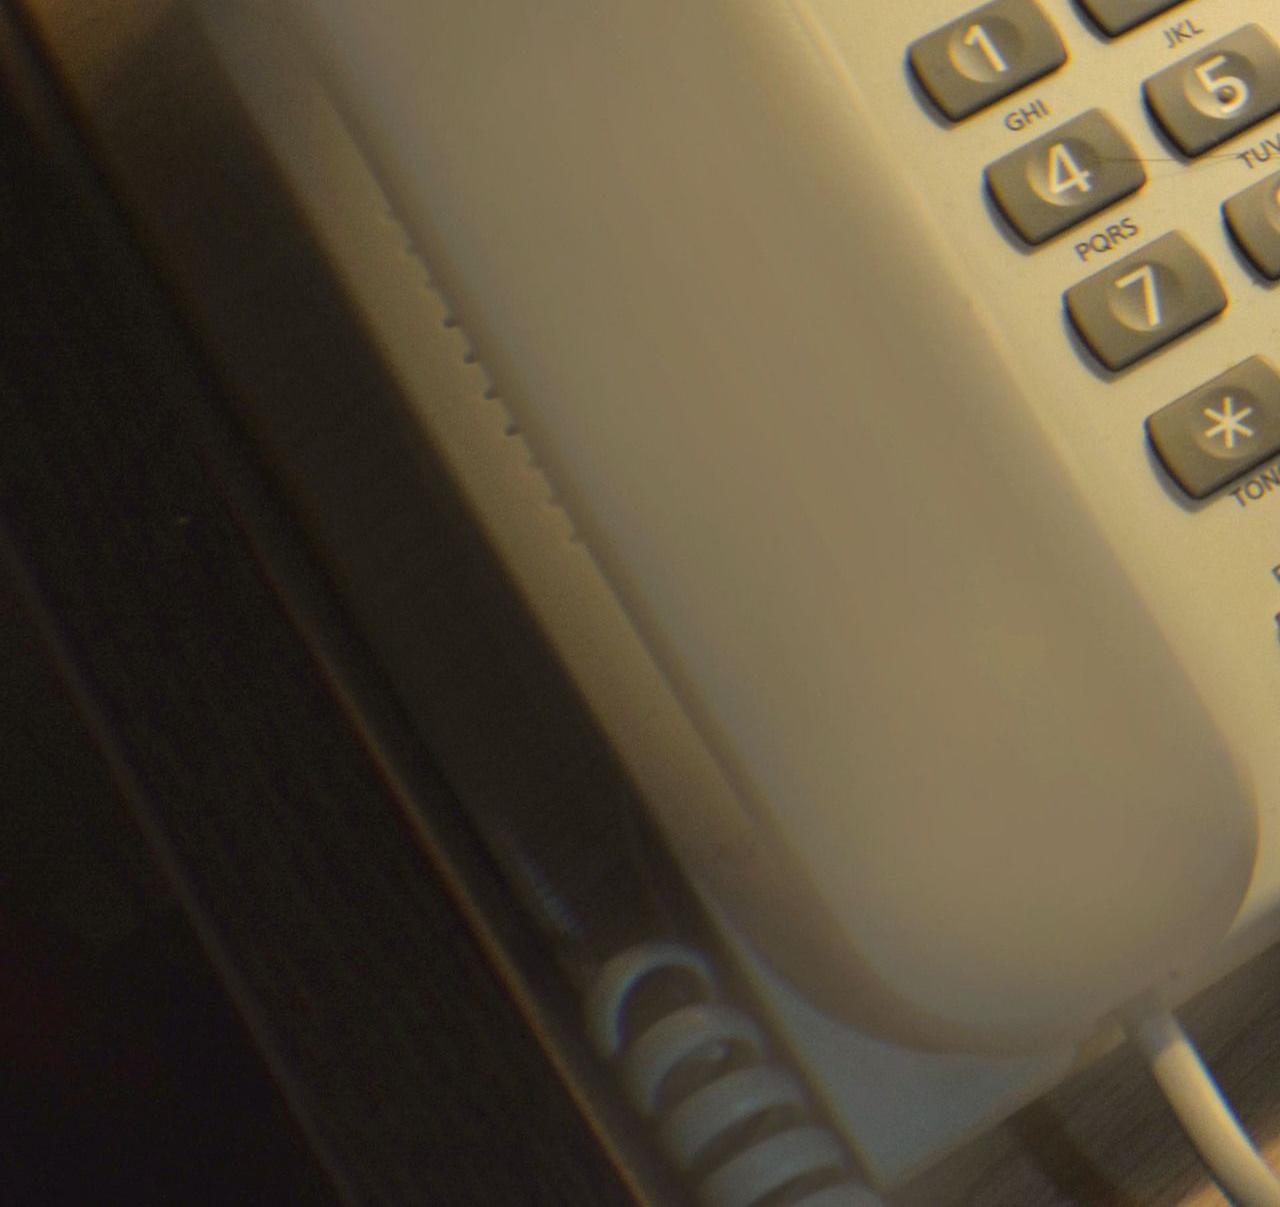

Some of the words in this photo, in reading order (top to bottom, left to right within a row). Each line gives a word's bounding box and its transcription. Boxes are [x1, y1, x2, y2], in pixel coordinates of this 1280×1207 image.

[964, 24, 1008, 73] 1
[1162, 18, 1205, 50] JKL
[1194, 55, 1249, 112] 5
[1004, 98, 1051, 132] GHI
[1046, 142, 1093, 193] 4
[1073, 216, 1141, 264] PQRS
[1114, 265, 1162, 328] 7
